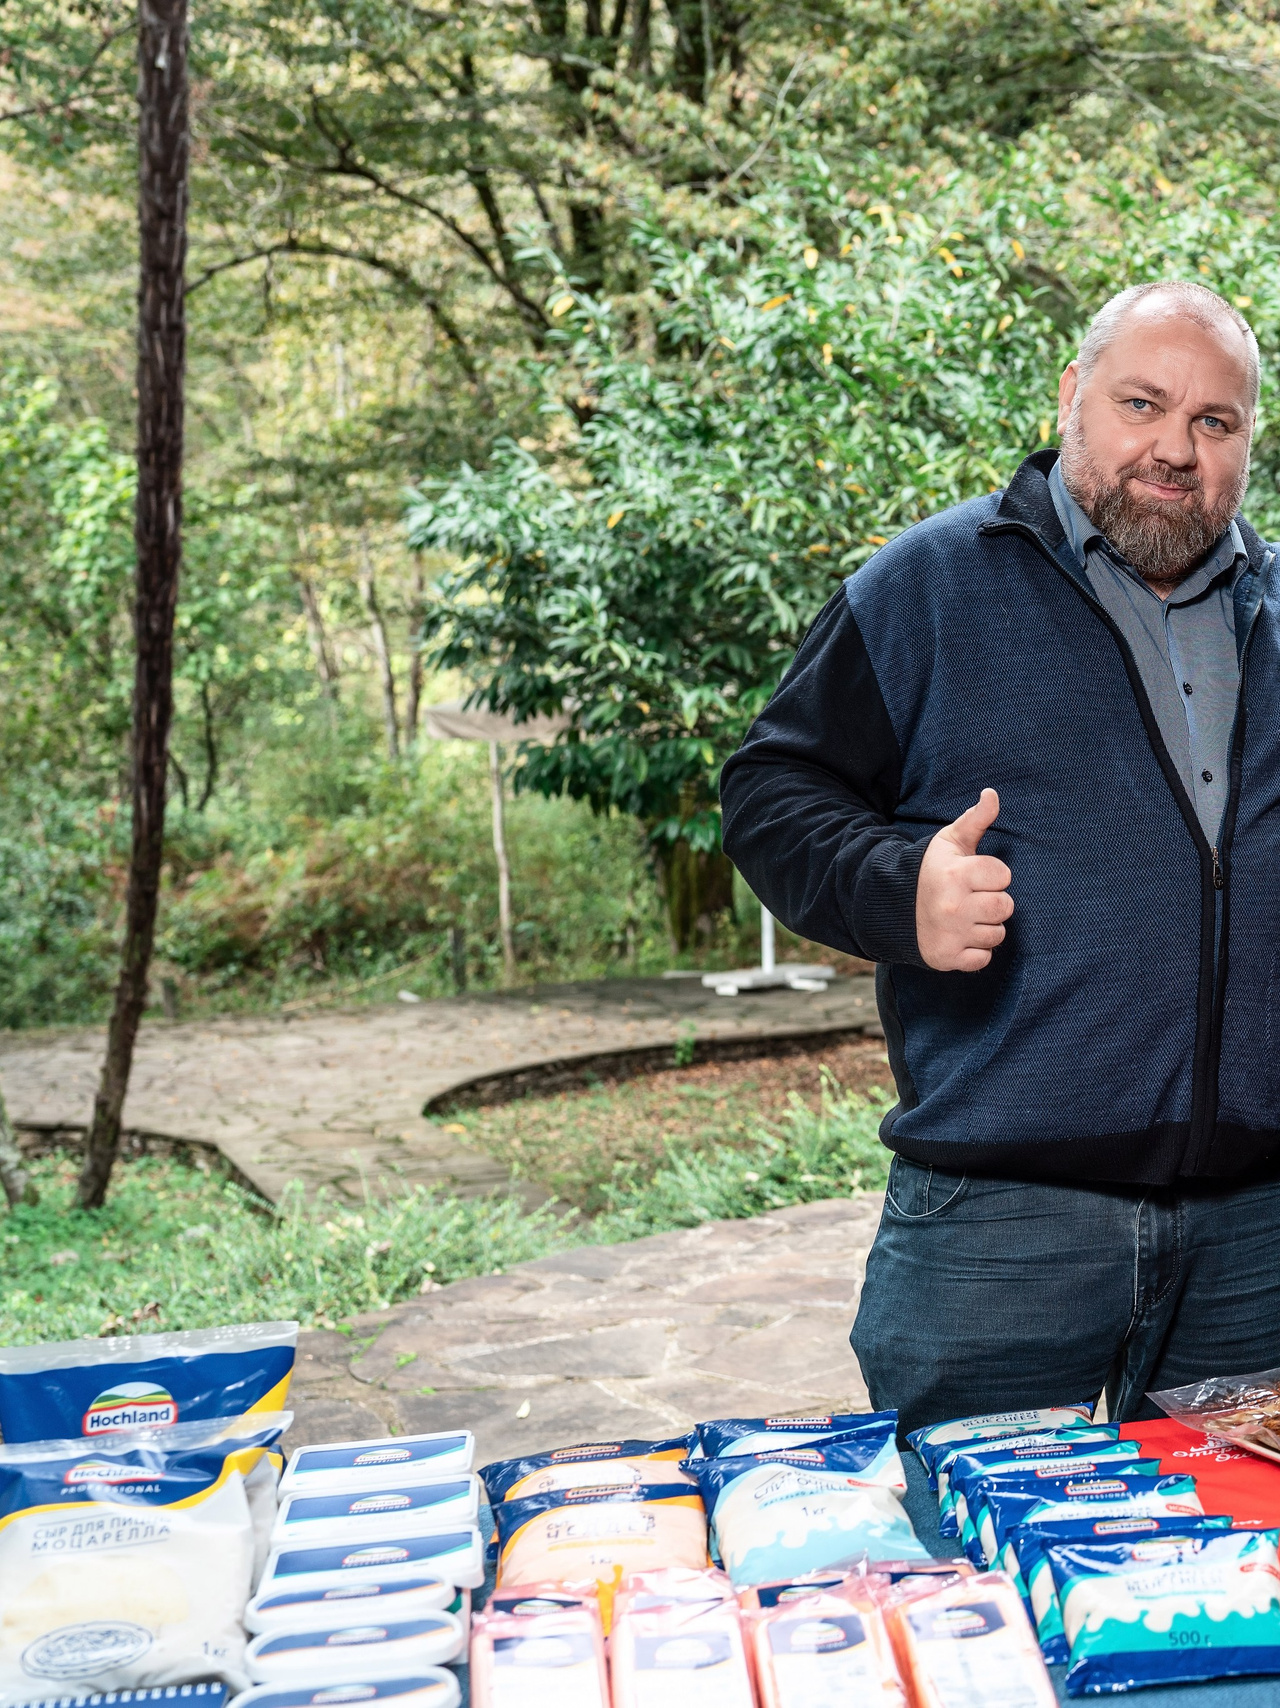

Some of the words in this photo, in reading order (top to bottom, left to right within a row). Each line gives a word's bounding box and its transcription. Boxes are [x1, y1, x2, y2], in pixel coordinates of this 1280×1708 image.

[90, 1408, 170, 1428] Hochland
[1016, 1451, 1074, 1460] PROFESSIONAL
[31, 1525, 171, 1552] МОЦАРЕЛЛА
[33, 1526, 68, 1540] СЫР
[72, 1521, 105, 1537] ДЛЯ
[1168, 1631, 1200, 1646] 500
